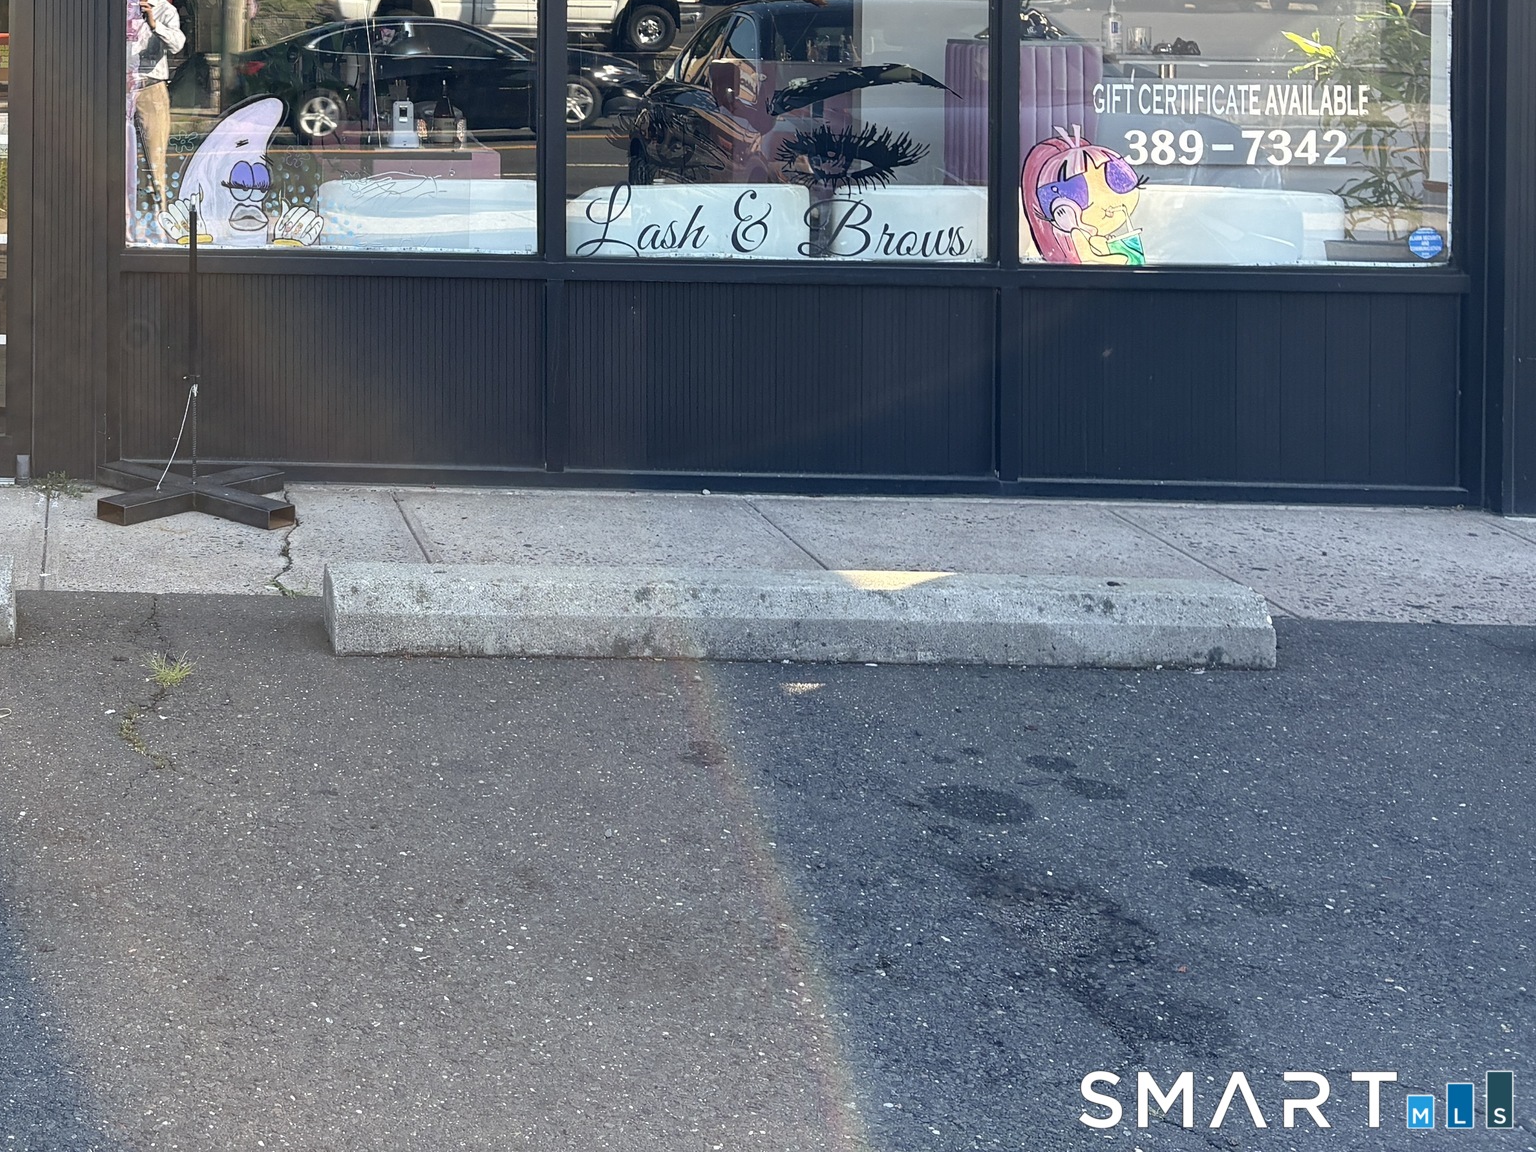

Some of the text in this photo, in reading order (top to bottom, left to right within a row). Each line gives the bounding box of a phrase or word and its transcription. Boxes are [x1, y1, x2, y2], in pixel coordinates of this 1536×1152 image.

[1093, 82, 1371, 116] GIFT CERTIFICATE AVAILABLE
[1124, 129, 1347, 166] 389-7342
[575, 181, 973, 258] Lash & Brows
